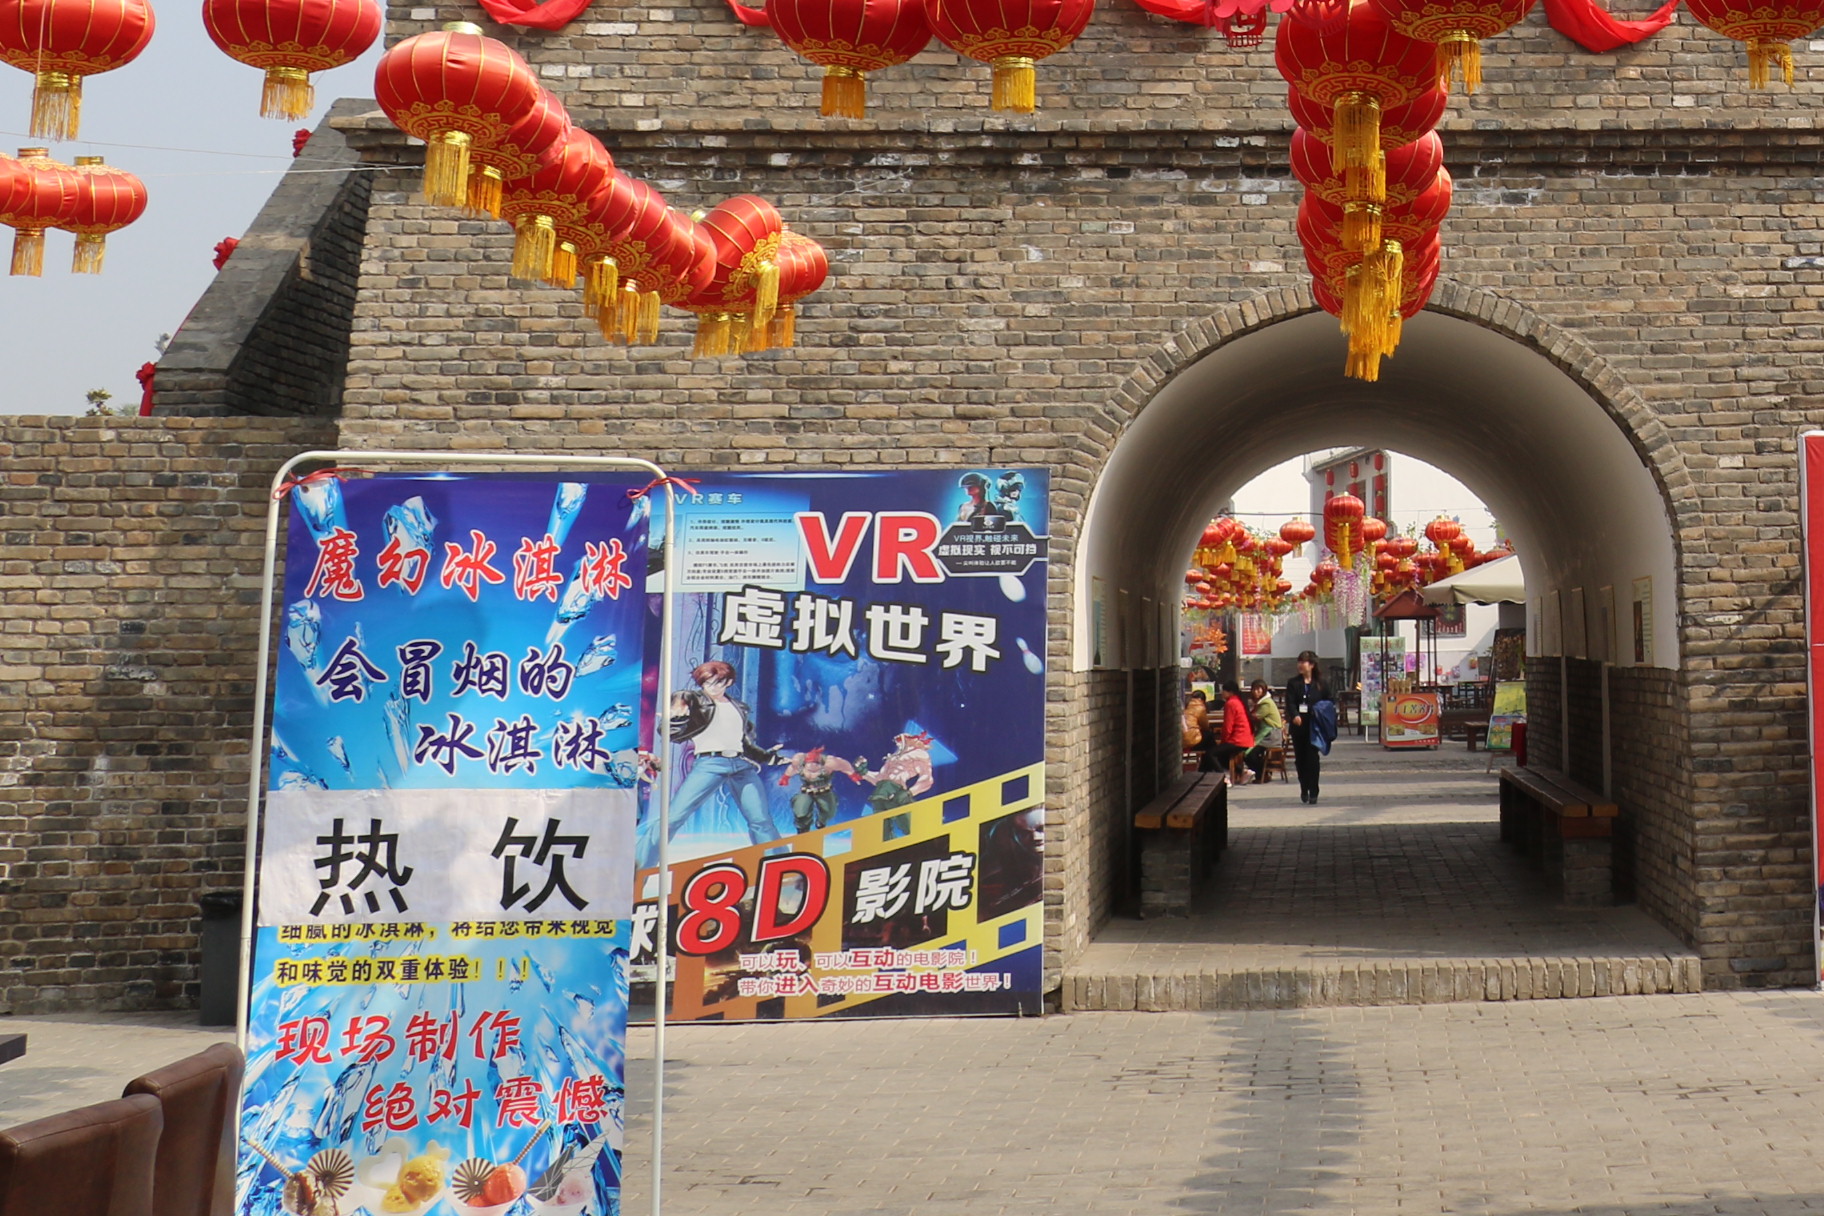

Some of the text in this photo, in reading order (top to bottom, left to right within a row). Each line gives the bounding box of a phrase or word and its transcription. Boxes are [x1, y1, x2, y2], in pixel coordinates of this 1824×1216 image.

[674, 492, 743, 505] VR赛车
[304, 526, 633, 602] 魔幻冰淇淋
[794, 512, 944, 583] VR
[938, 543, 1037, 556] 虚拟现实 视不可挡
[720, 587, 1001, 672] 虚拟世界
[315, 636, 576, 703] 会冒烟的
[414, 713, 612, 776] 冰淇淋
[309, 817, 591, 917] 热饮
[676, 855, 828, 954] 8D
[851, 853, 975, 924] 影院
[274, 1009, 522, 1066] 现场制作
